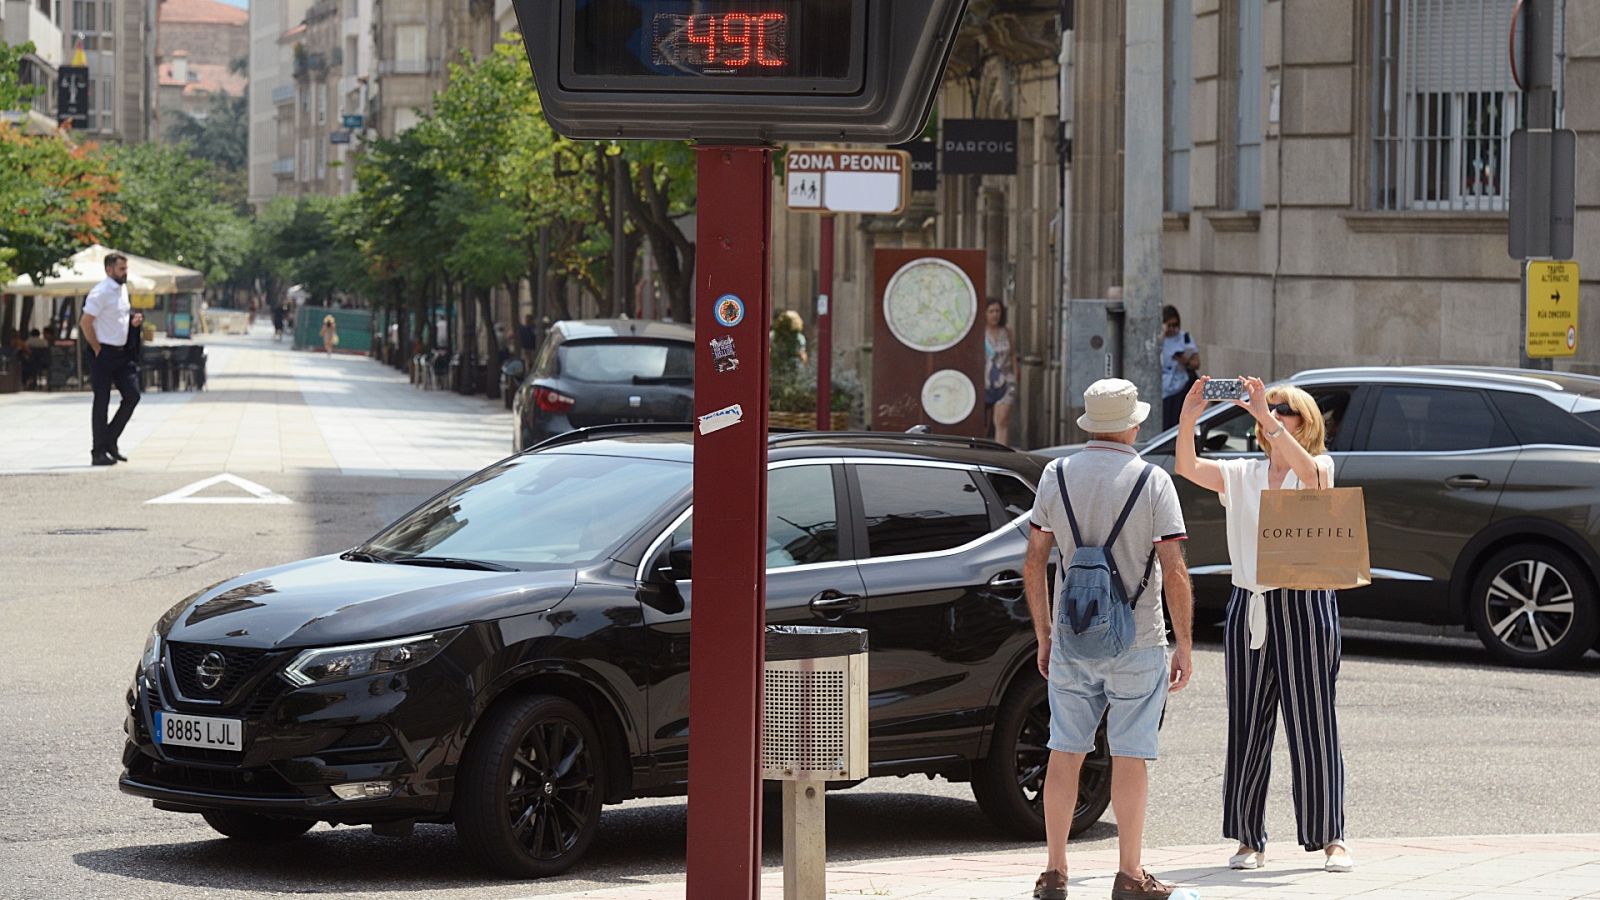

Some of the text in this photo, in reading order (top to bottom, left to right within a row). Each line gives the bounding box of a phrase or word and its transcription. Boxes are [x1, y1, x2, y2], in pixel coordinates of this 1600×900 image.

[789, 154, 901, 170] ZONA PEONIL
[1262, 527, 1354, 538] CORTEFIEL
[166, 718, 235, 745] 8885 LJL
